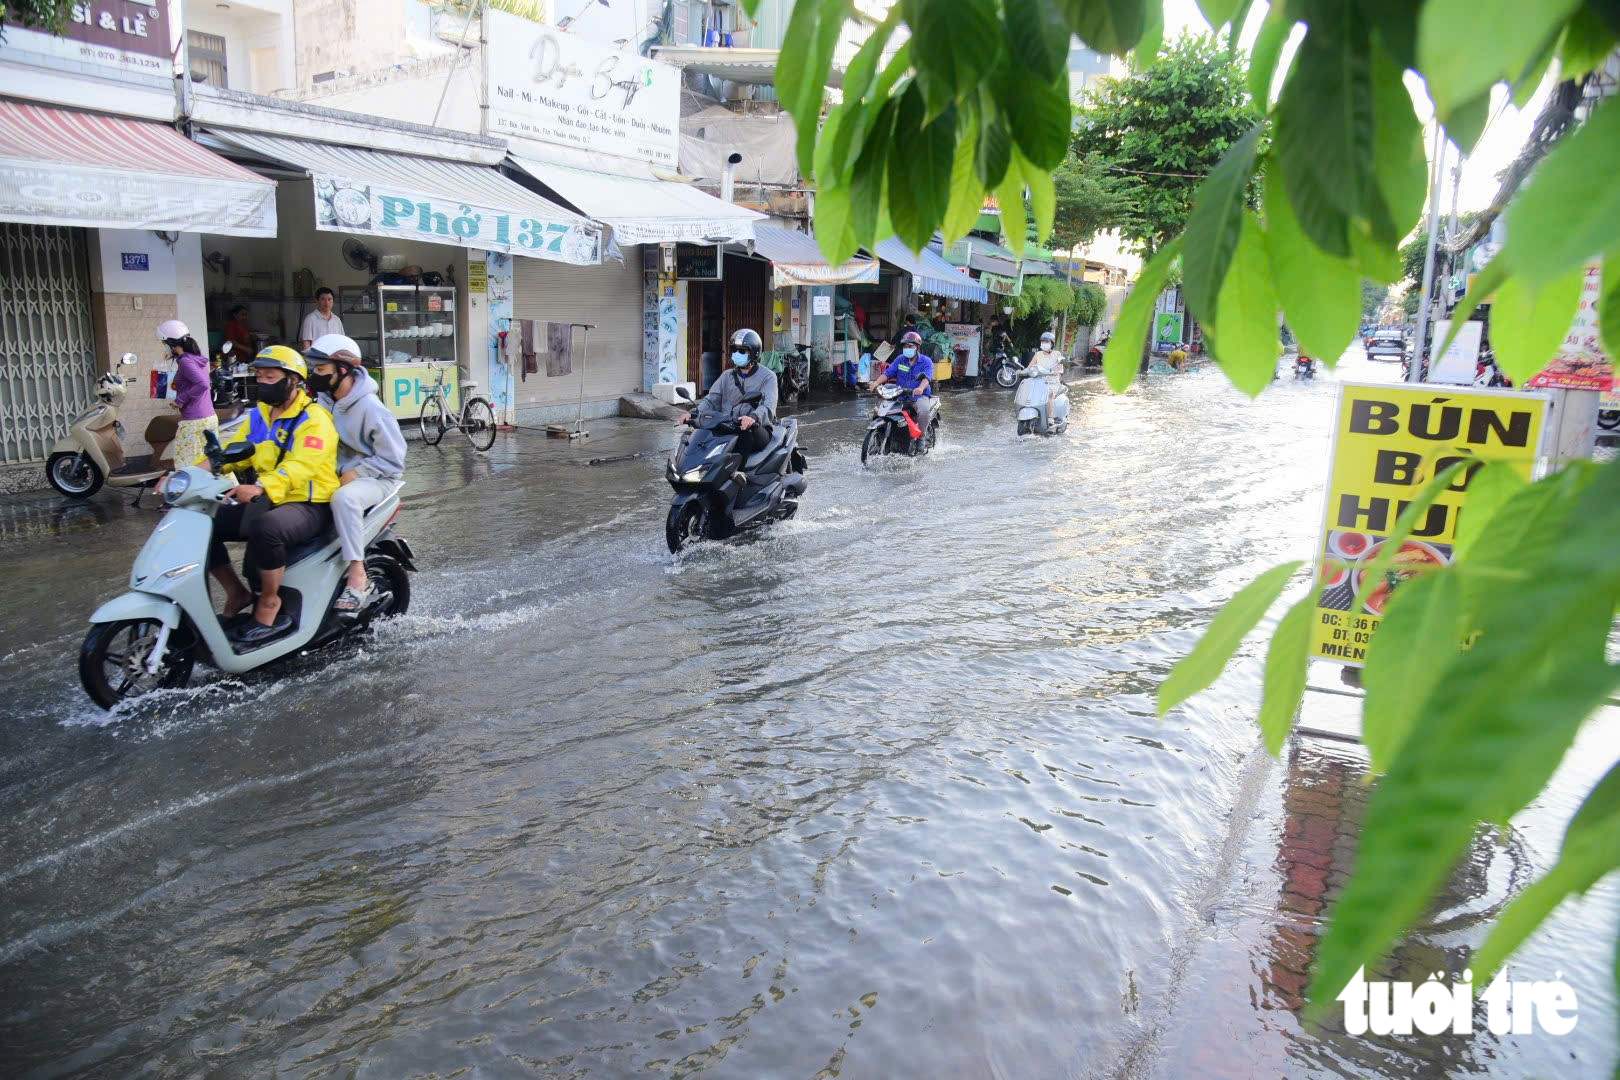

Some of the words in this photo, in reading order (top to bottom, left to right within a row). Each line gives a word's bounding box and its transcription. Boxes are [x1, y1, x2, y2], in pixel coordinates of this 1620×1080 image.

[99, 11, 116, 31] &
[122, 12, 147, 37] LẺ
[497, 85, 514, 99] Nail
[539, 95, 570, 113] Makeup
[377, 195, 483, 239] Phở
[494, 214, 572, 253] 137
[1349, 397, 1532, 447] BÚN
[1374, 448, 1485, 492] BÒ
[1337, 494, 1463, 540] HU
[1321, 613, 1342, 627] ĐC:
